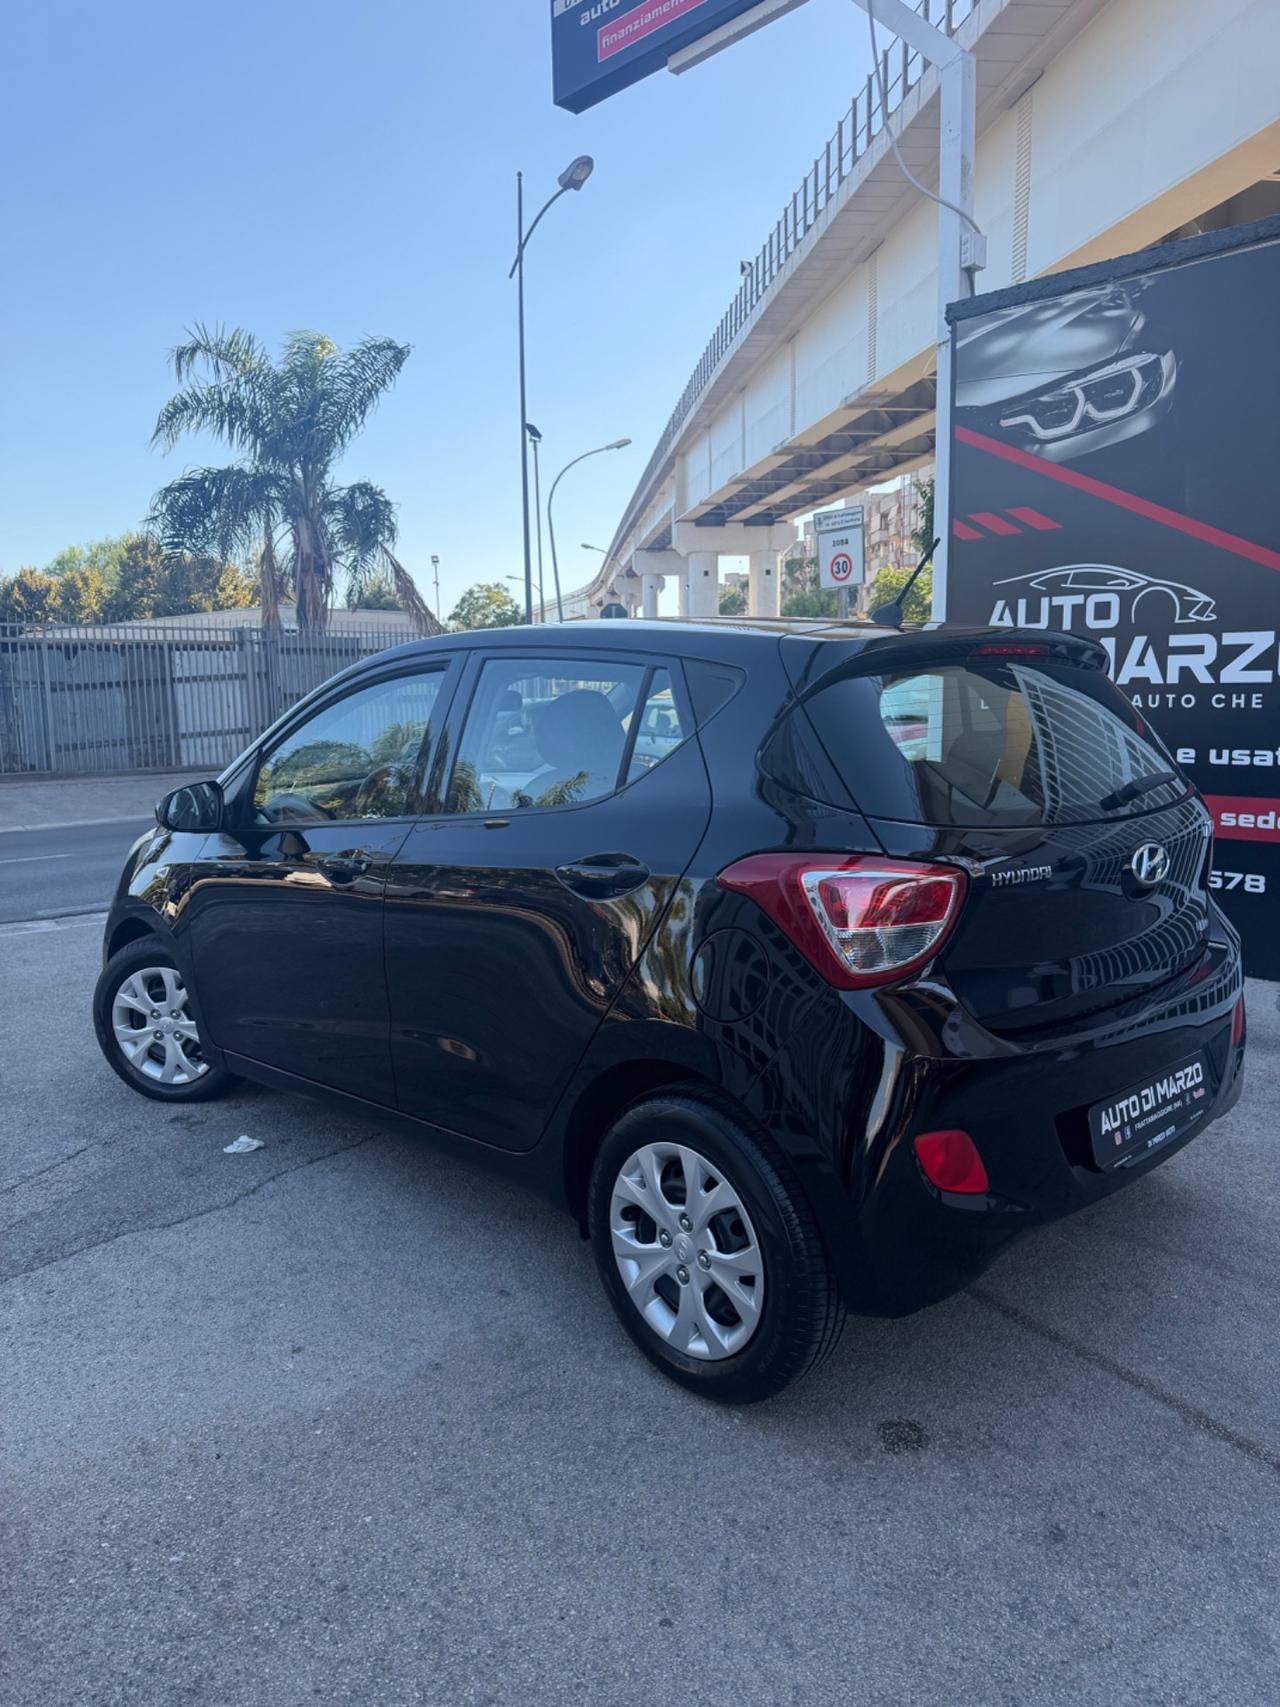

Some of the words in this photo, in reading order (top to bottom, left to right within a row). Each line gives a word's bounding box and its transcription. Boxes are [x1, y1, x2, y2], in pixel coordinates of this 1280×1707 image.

[580, 0, 620, 26] auto
[602, 0, 685, 48] finanziamen
[834, 561, 848, 575] 30
[988, 592, 1121, 631] AUTO
[1100, 631, 1280, 685] ARZ
[1131, 693, 1197, 709] AUTO
[1211, 693, 1264, 709] CHE
[1176, 747, 1197, 765] e
[1220, 811, 1280, 830] sed
[991, 865, 1053, 887] HYUNDAI
[1101, 1094, 1141, 1136] AUTO
[1140, 1086, 1157, 1112] DI
[1156, 1062, 1204, 1104] MARZO
